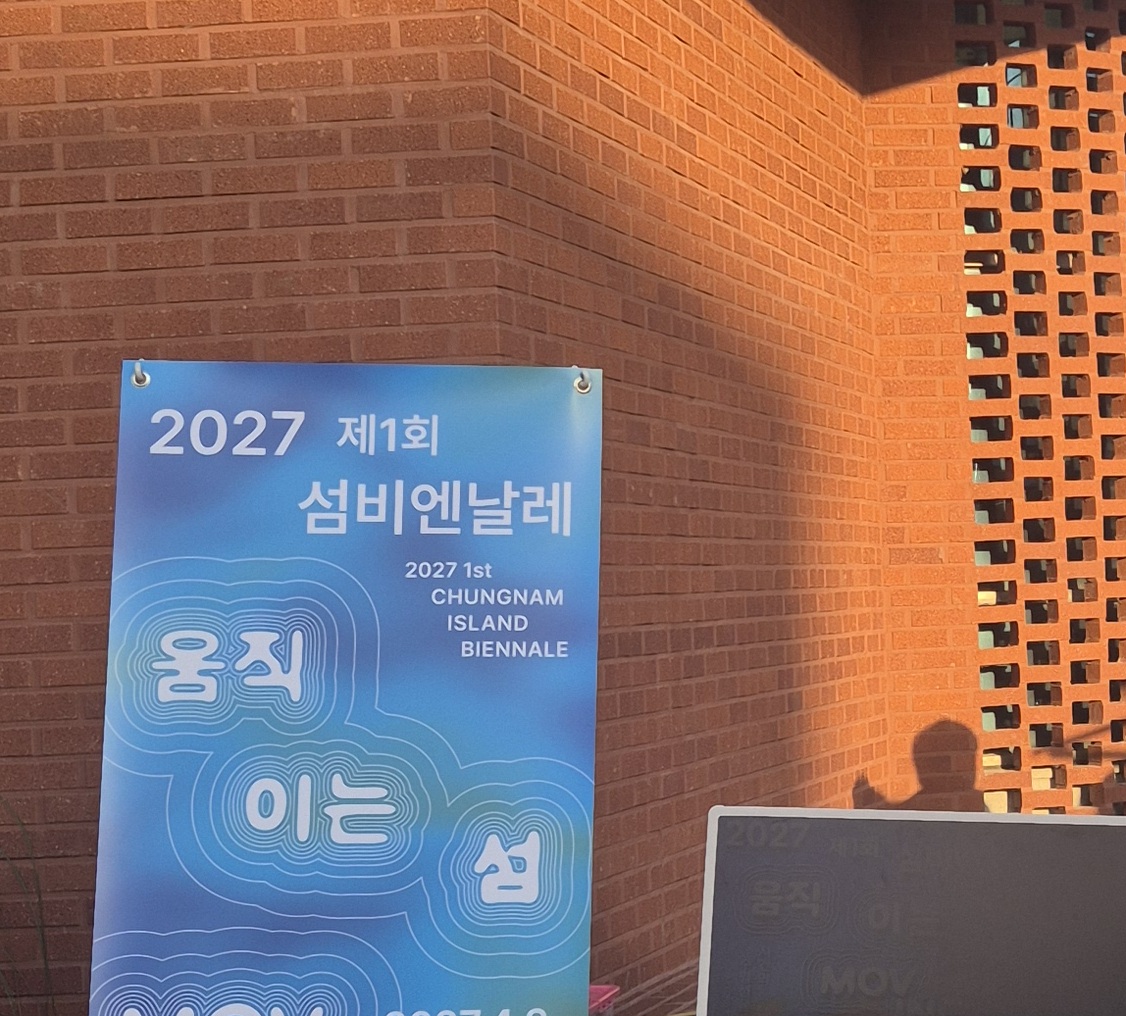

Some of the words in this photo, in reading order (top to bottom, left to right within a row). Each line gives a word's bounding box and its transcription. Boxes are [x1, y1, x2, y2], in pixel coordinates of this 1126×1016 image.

[150, 408, 305, 456] 2027
[336, 414, 439, 456] 제1회
[298, 479, 572, 536] 섬비엔날레
[405, 562, 457, 579] 2027
[463, 561, 492, 579] 1st
[431, 588, 564, 606] CHUNGNAM
[447, 615, 529, 631] ISLAND
[151, 630, 303, 702] 움직
[461, 641, 569, 658] BIENNALE
[245, 773, 396, 845] 이는
[474, 831, 540, 904] 섬
